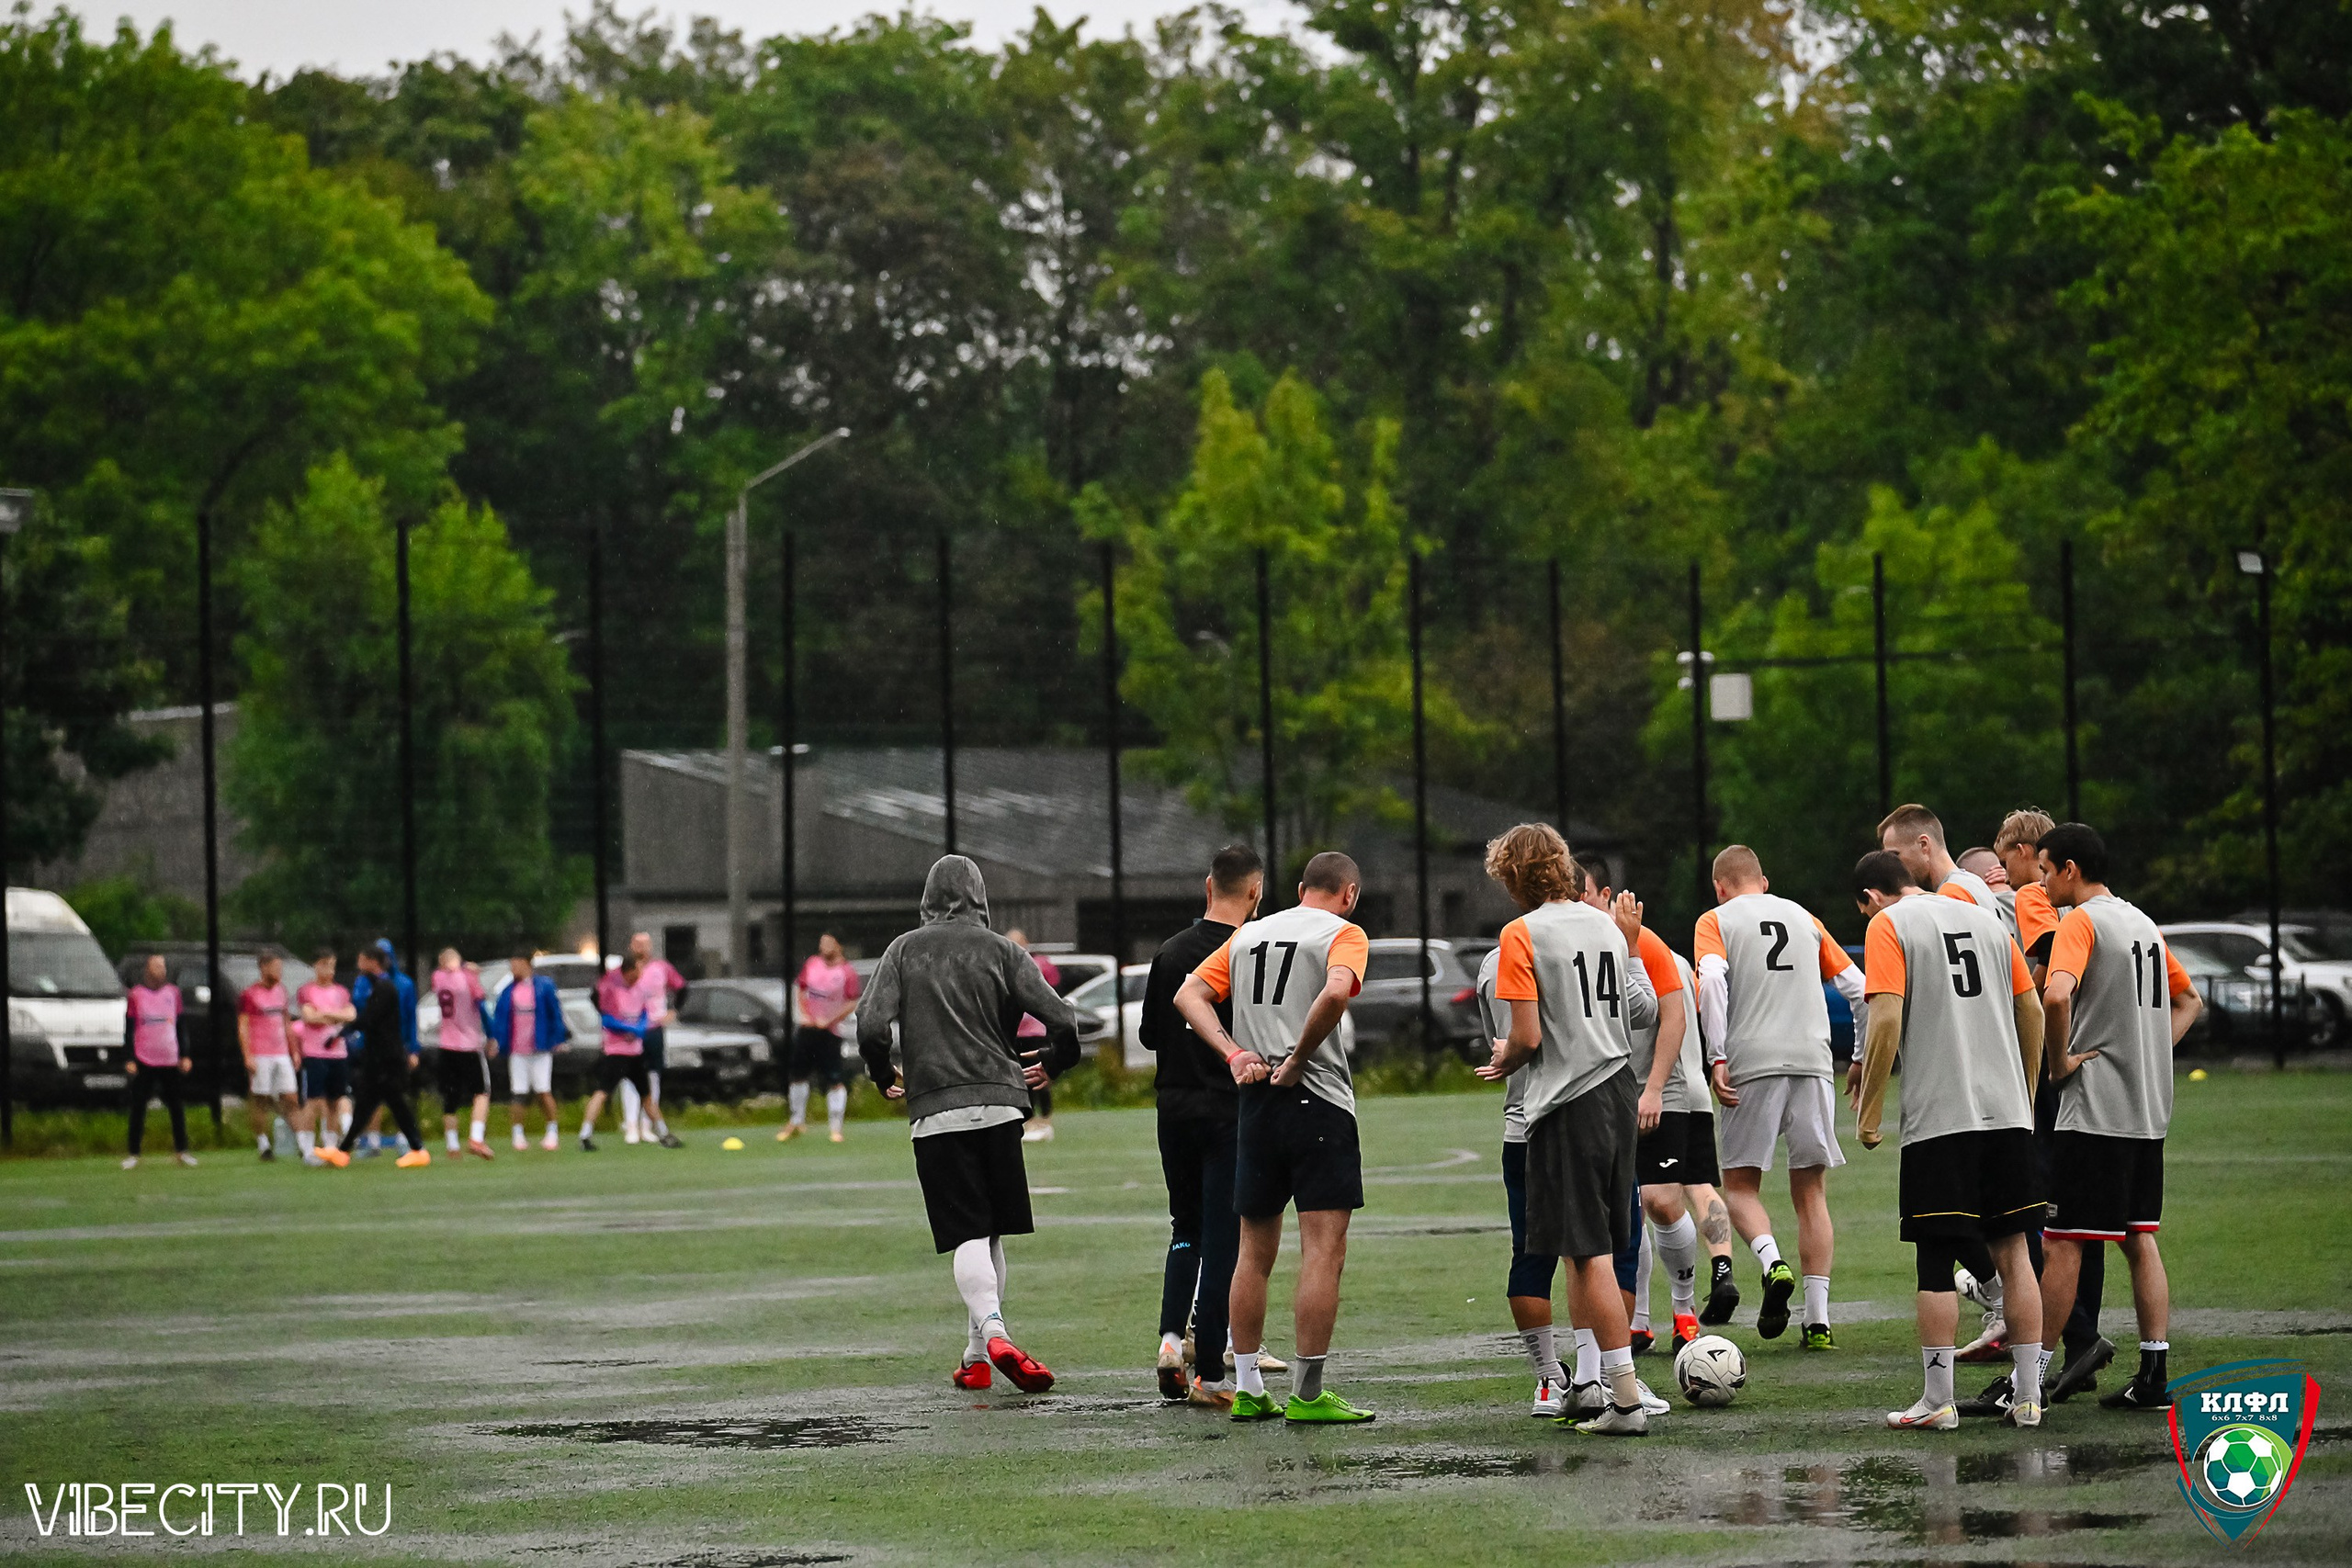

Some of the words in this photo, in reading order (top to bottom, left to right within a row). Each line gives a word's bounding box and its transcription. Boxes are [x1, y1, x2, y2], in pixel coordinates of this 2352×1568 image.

[1249, 941, 1298, 1006] 17
[1759, 920, 1794, 971] 2
[1942, 931, 1983, 998] 5
[2131, 940, 2163, 1010] 11
[1572, 951, 1621, 1018] 14
